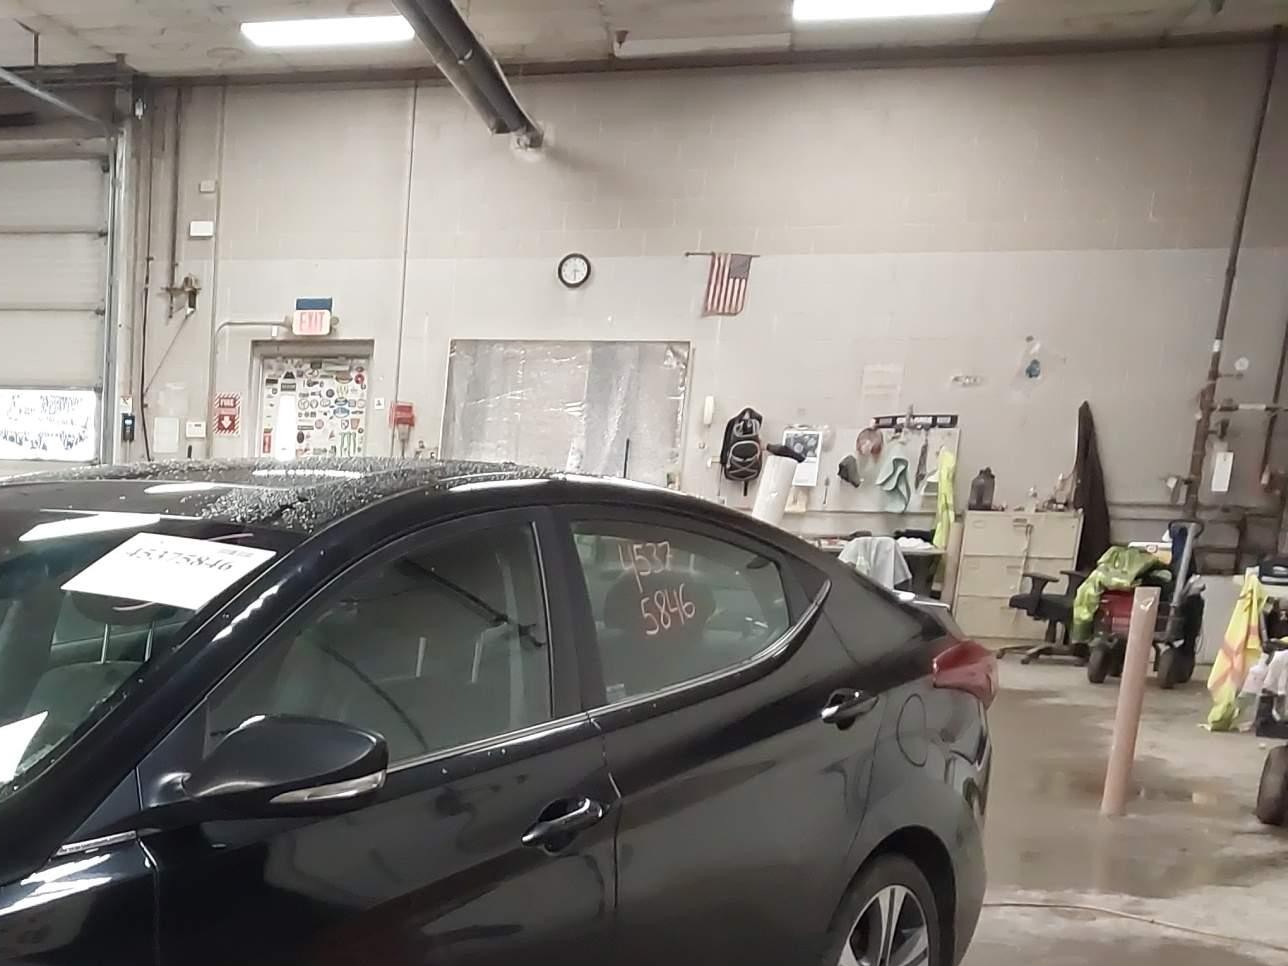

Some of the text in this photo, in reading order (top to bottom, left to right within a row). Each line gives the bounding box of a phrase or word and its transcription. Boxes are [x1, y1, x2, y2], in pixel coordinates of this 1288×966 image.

[299, 311, 325, 331] EXIT
[618, 541, 672, 593] 4537
[641, 583, 696, 635] 5846
